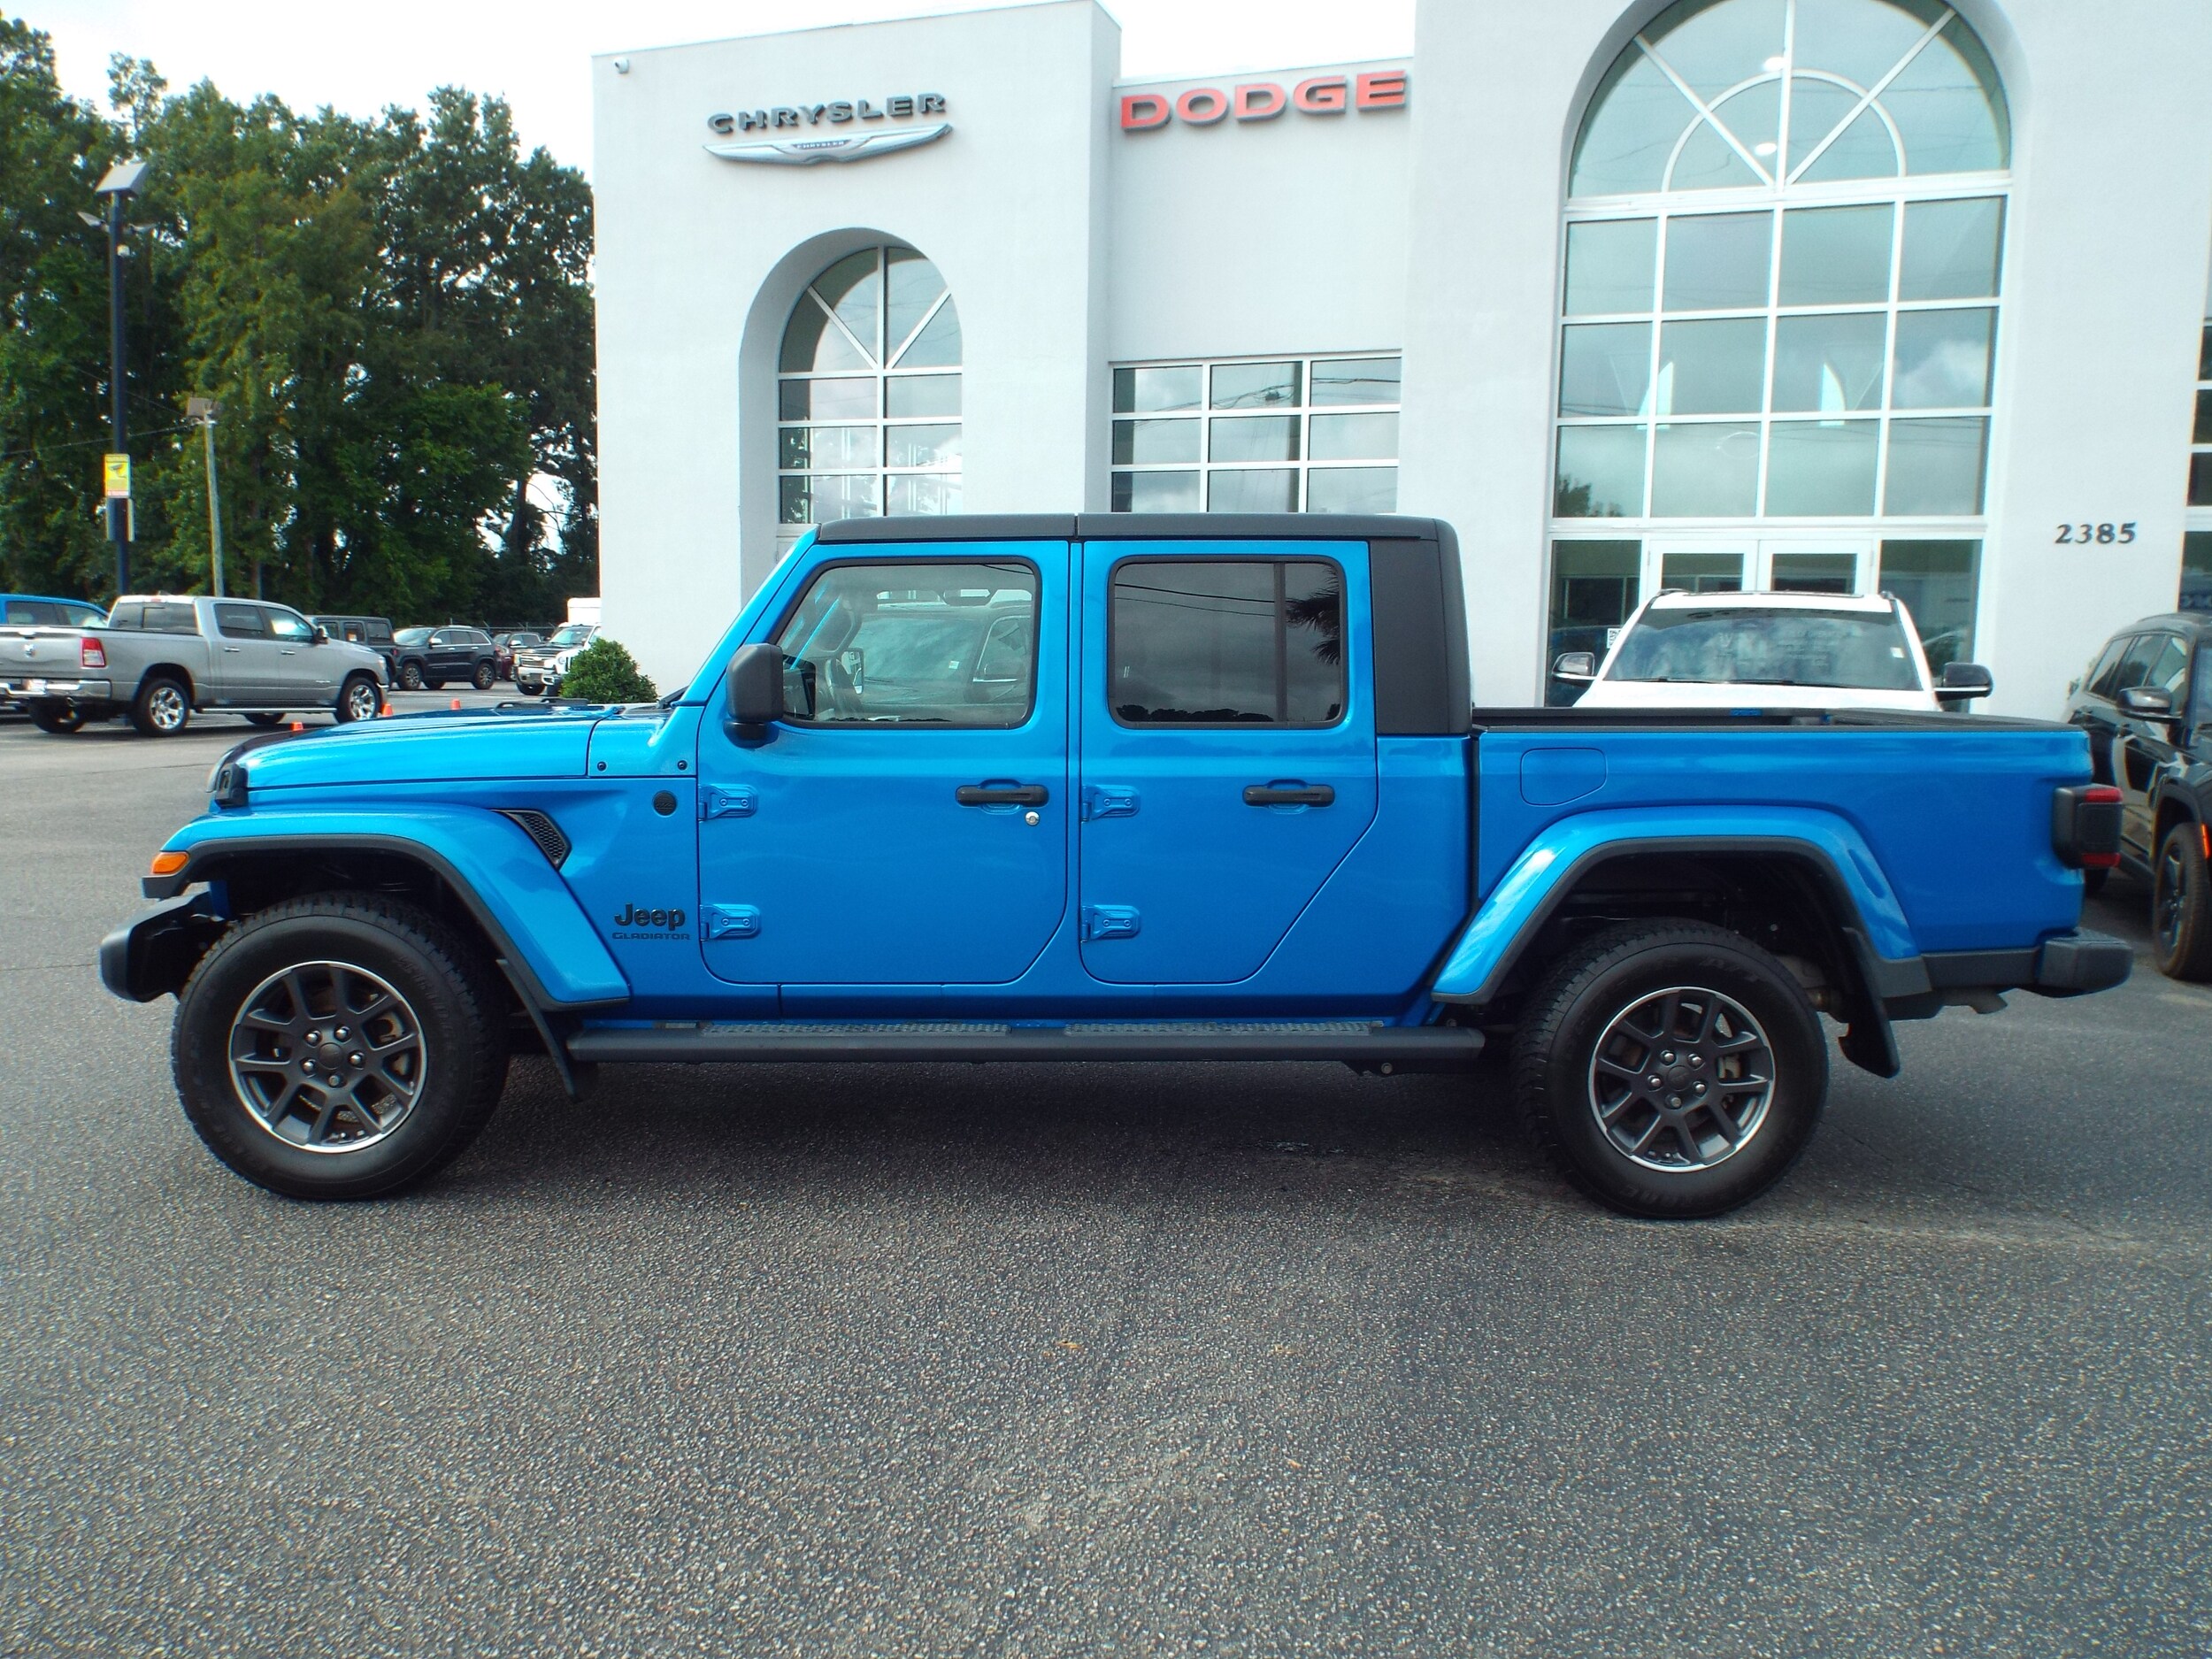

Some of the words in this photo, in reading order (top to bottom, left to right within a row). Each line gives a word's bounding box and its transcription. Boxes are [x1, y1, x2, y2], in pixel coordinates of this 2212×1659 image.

[707, 92, 947, 134] CHRYSLER
[1120, 69, 1409, 133] DODGE
[2055, 521, 2137, 544] 2385
[614, 902, 686, 932] Jeep
[611, 932, 691, 941] GLADIATOR
